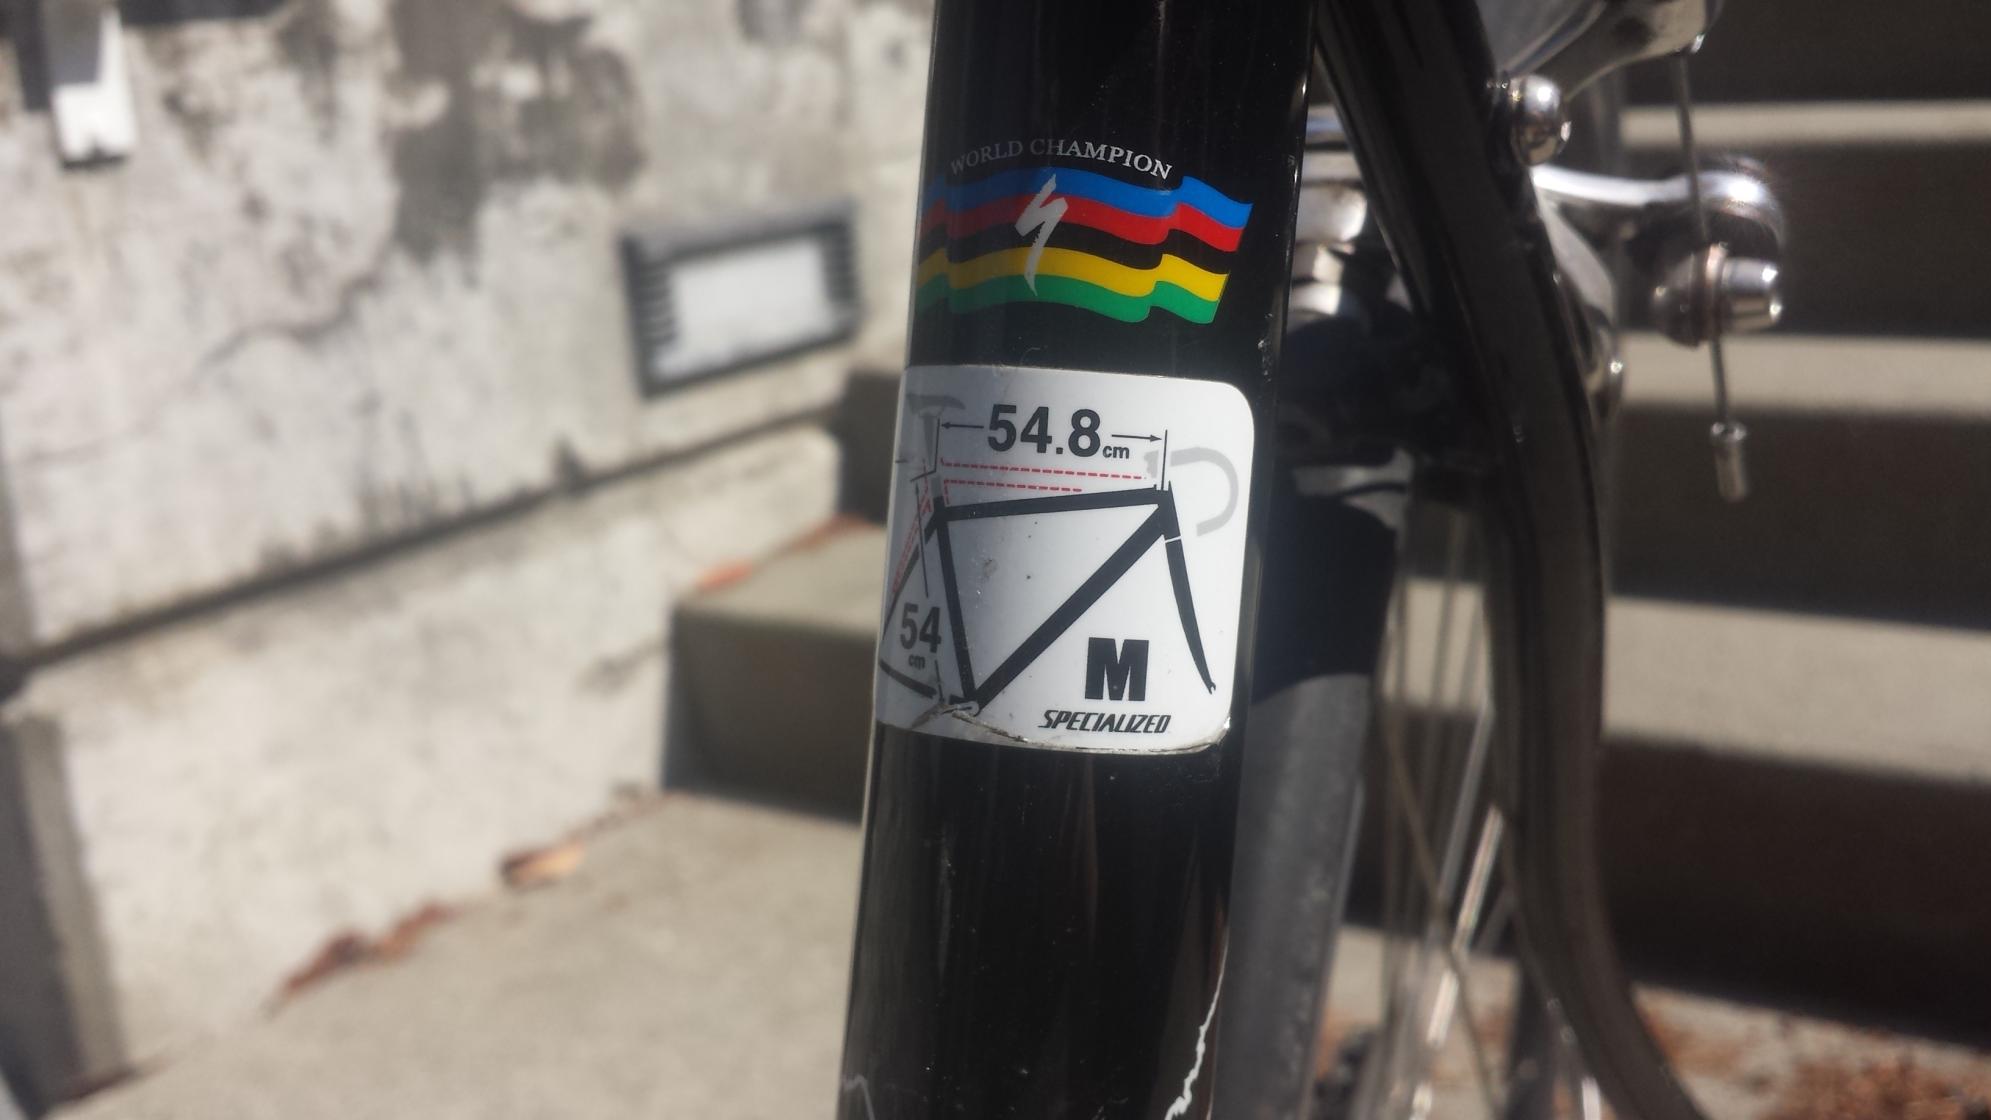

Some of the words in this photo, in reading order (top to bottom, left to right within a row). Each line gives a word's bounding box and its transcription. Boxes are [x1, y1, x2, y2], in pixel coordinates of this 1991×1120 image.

[950, 139, 1024, 176] WORLD
[1029, 138, 1173, 180] CHAMPION
[986, 403, 1101, 458] 54.8
[1102, 444, 1130, 459] cm
[900, 602, 942, 654] 54
[908, 654, 926, 670] cm
[1085, 637, 1149, 701] M
[1038, 709, 1172, 734] SPECIALIZED
